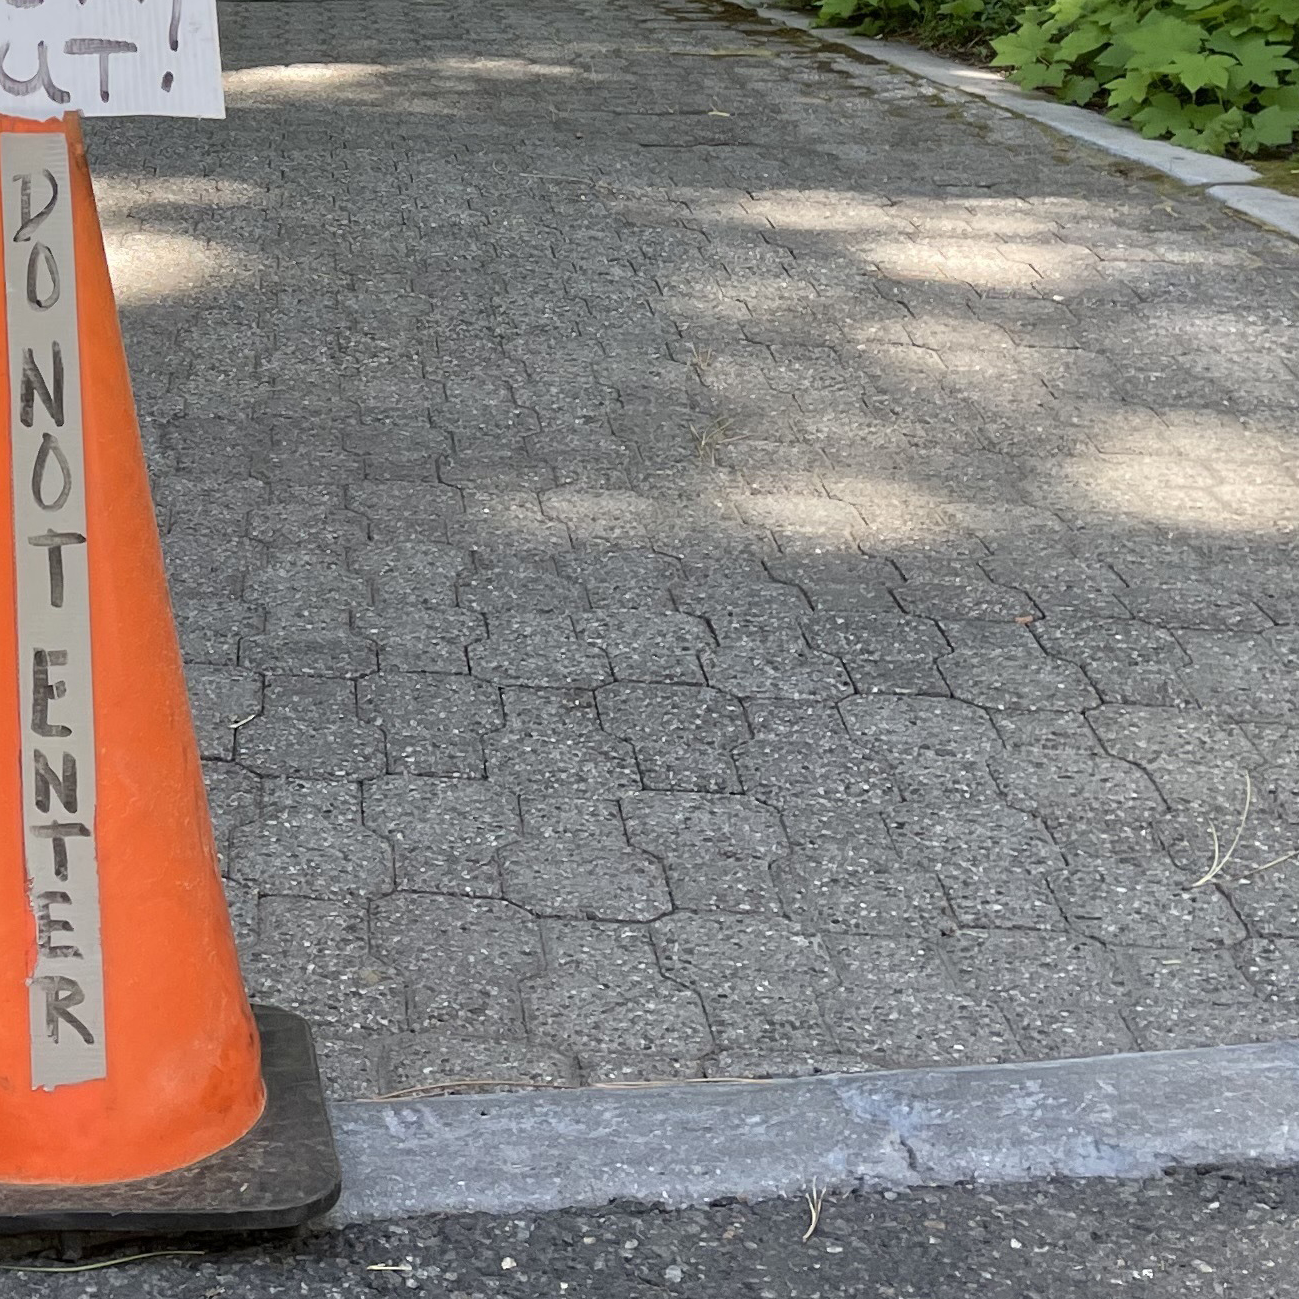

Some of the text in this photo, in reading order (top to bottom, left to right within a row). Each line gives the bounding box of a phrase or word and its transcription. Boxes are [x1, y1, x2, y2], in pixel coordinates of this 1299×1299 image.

[12, 167, 96, 1046] DO NOT ENTER
